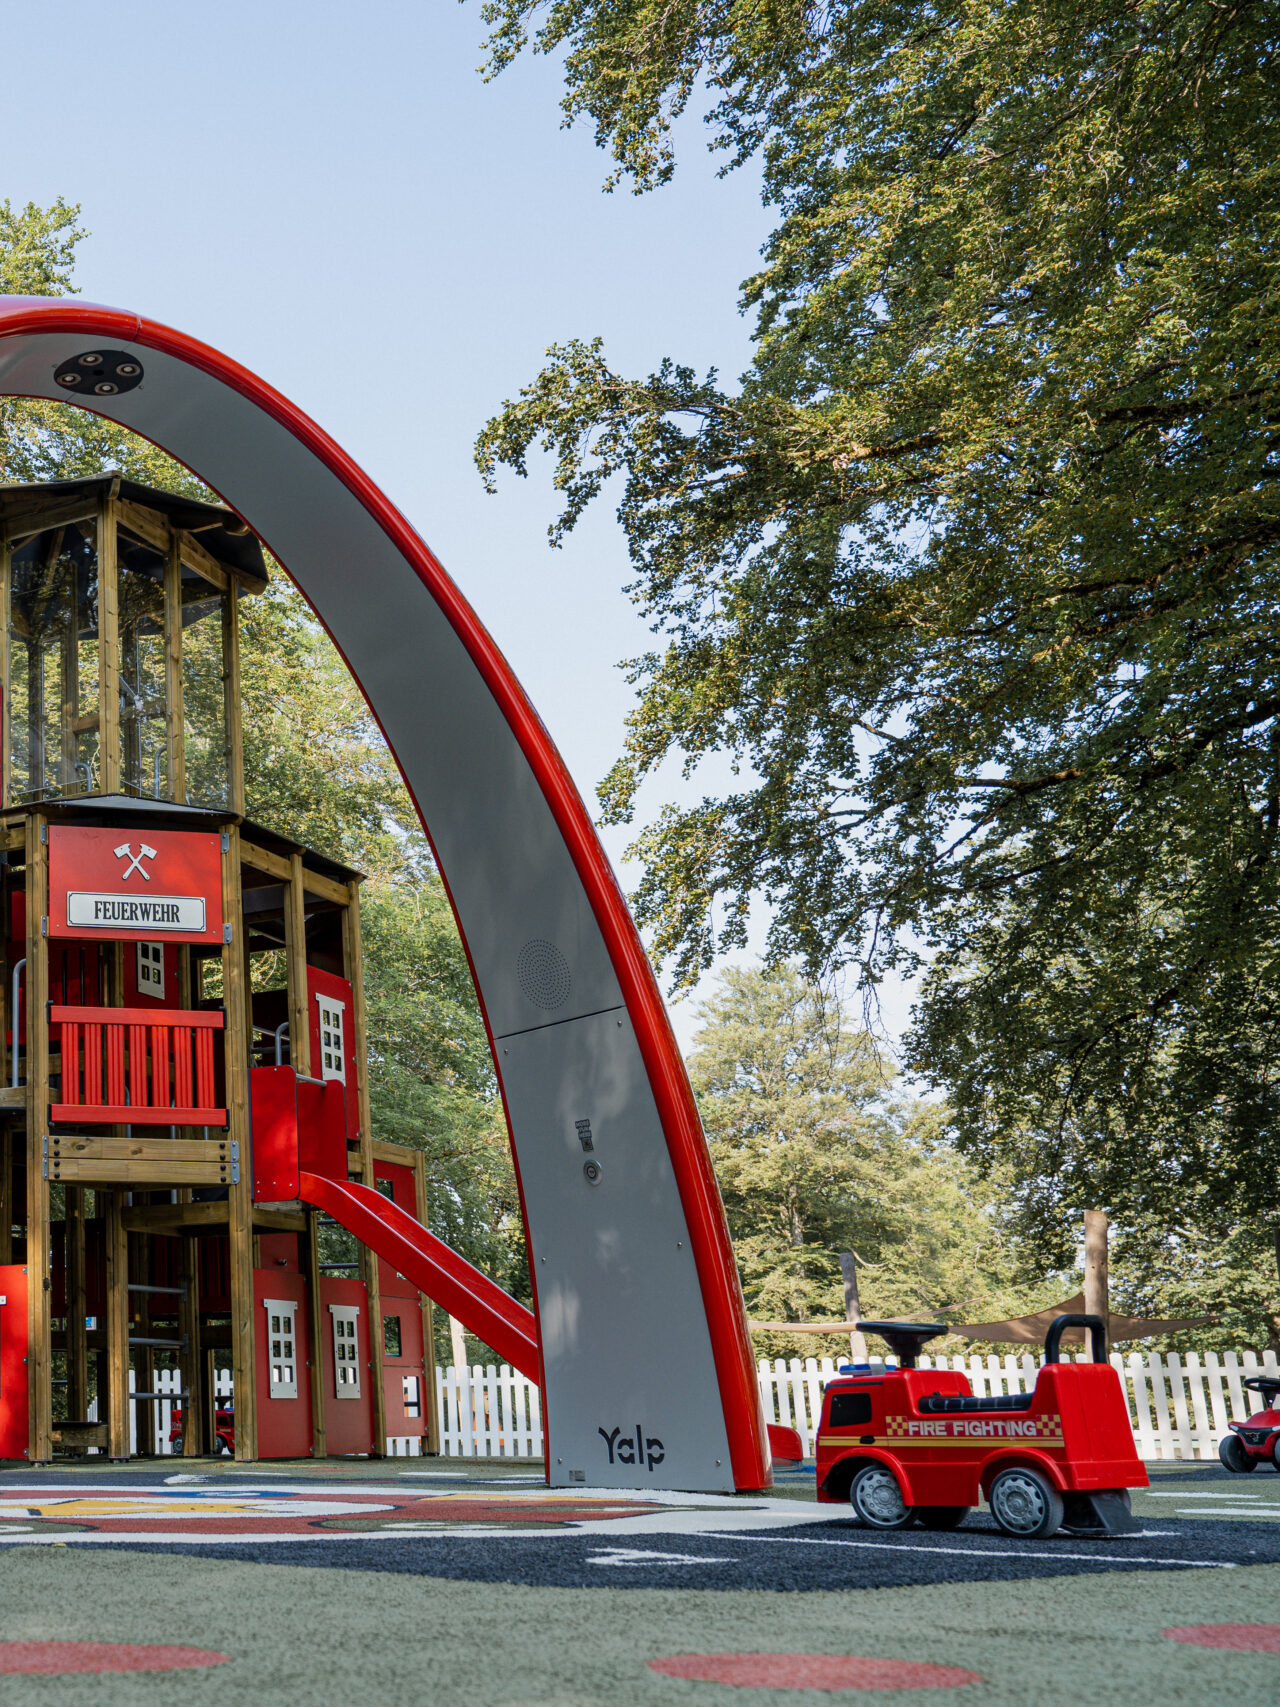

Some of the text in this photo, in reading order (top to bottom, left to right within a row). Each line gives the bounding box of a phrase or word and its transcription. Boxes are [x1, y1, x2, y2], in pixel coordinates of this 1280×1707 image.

[94, 900, 180, 923] FEUERWEHR
[908, 1421, 1037, 1436] FIRE FIGHTING
[598, 1424, 665, 1472] Yalp
